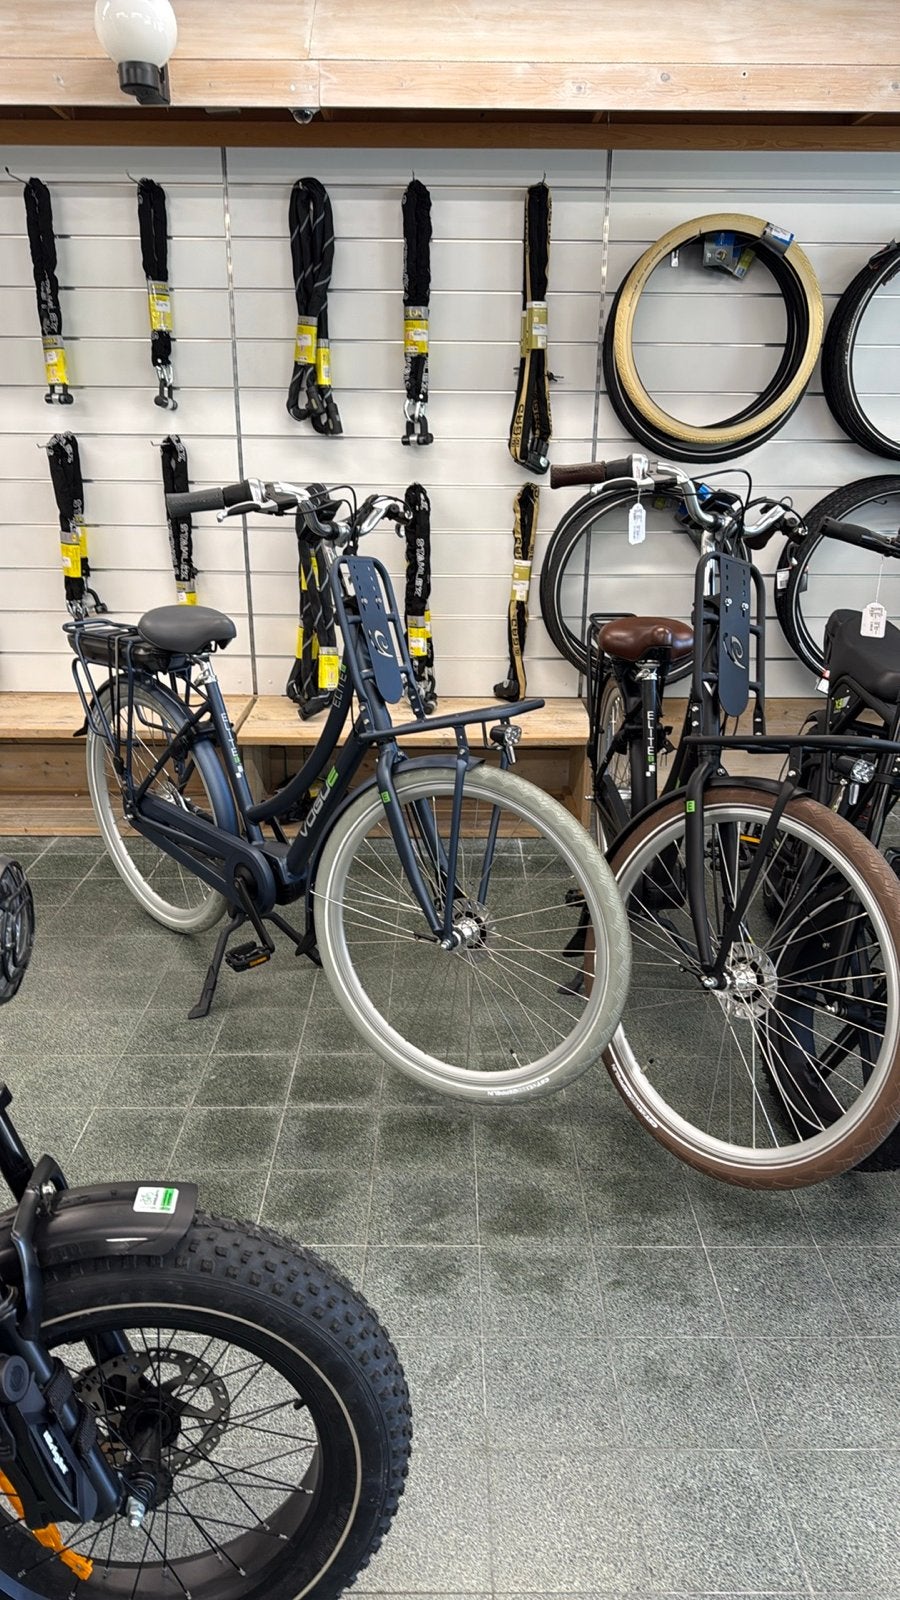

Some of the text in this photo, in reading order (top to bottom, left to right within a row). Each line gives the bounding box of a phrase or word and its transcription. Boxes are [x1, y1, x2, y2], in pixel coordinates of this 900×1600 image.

[221, 712, 238, 756] ELITE
[647, 710, 655, 755] ELITE
[300, 765, 339, 837] VOGUE
